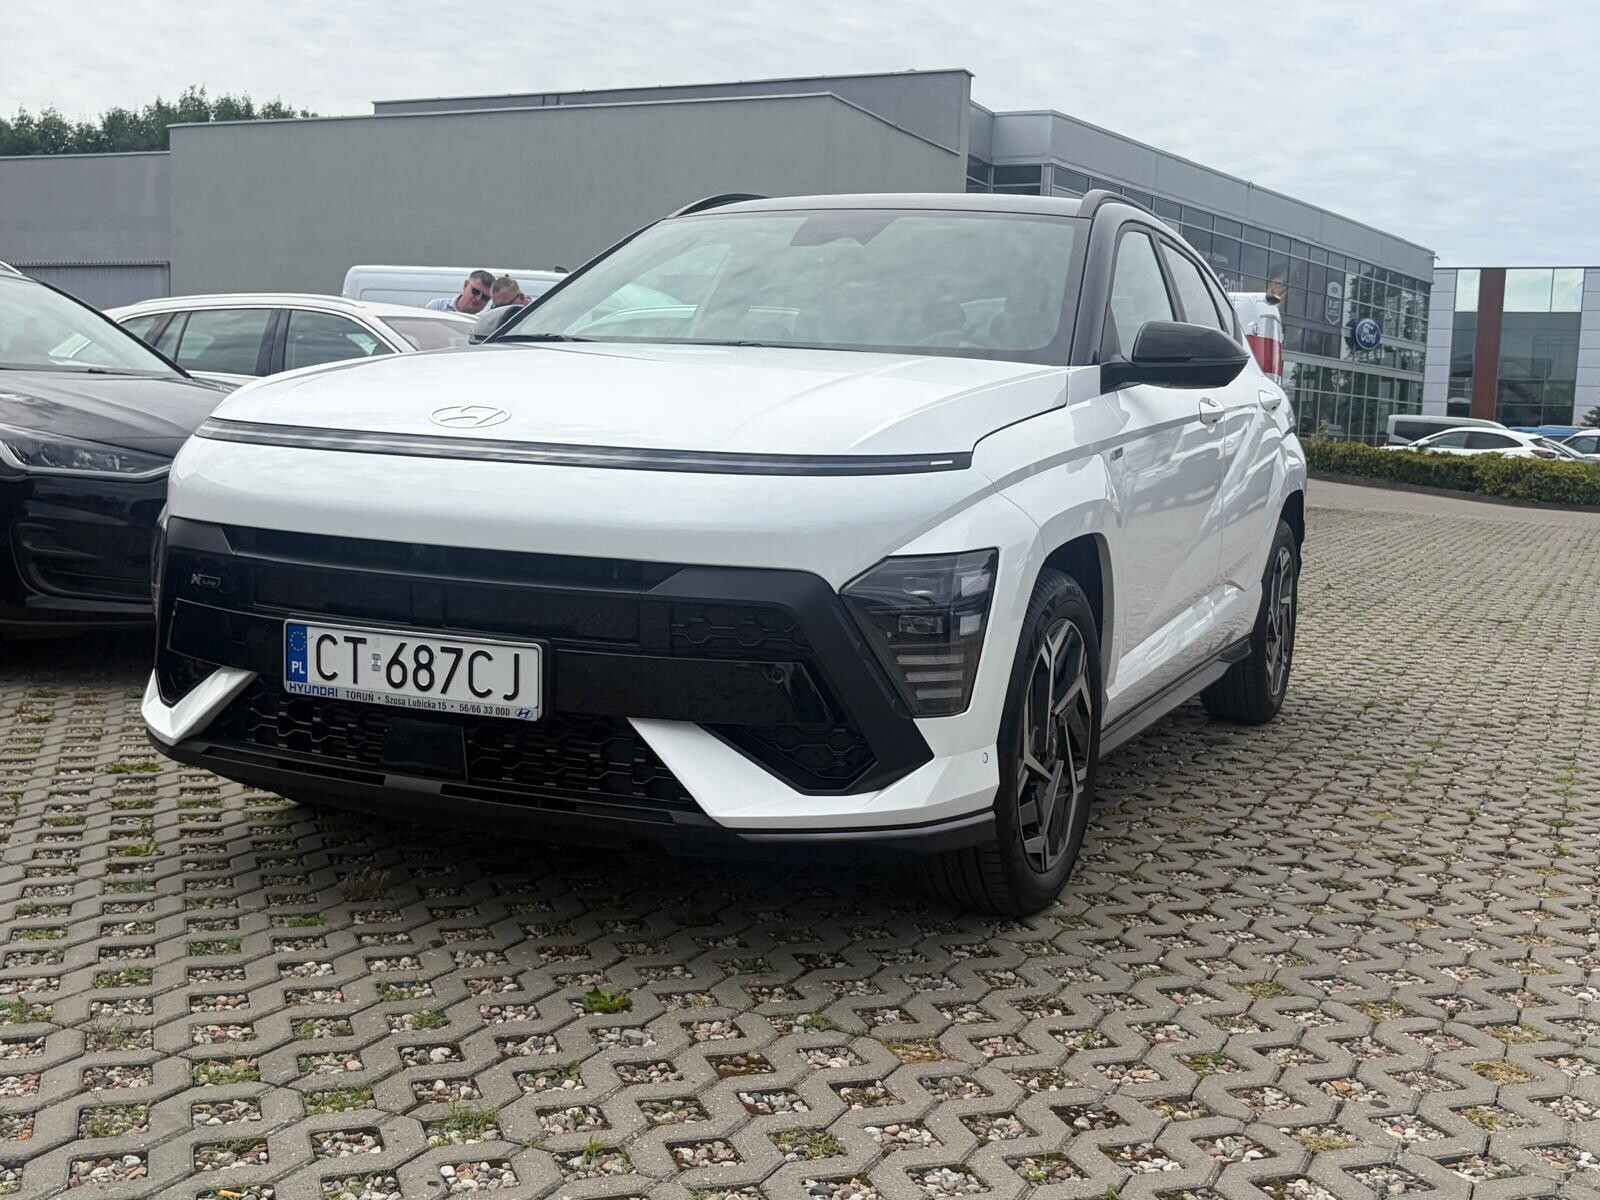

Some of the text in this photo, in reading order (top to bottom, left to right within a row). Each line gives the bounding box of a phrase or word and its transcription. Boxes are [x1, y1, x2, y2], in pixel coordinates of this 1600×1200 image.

[291, 661, 306, 675] PL
[316, 634, 520, 701] CT 687CJ
[289, 683, 338, 697] HYUNDAI
[385, 695, 406, 706] Szosa
[408, 698, 436, 709] Lubicka
[437, 702, 447, 710] 15
[459, 703, 481, 713] 56/66
[483, 706, 493, 715] 33
[495, 707, 510, 716] 000
